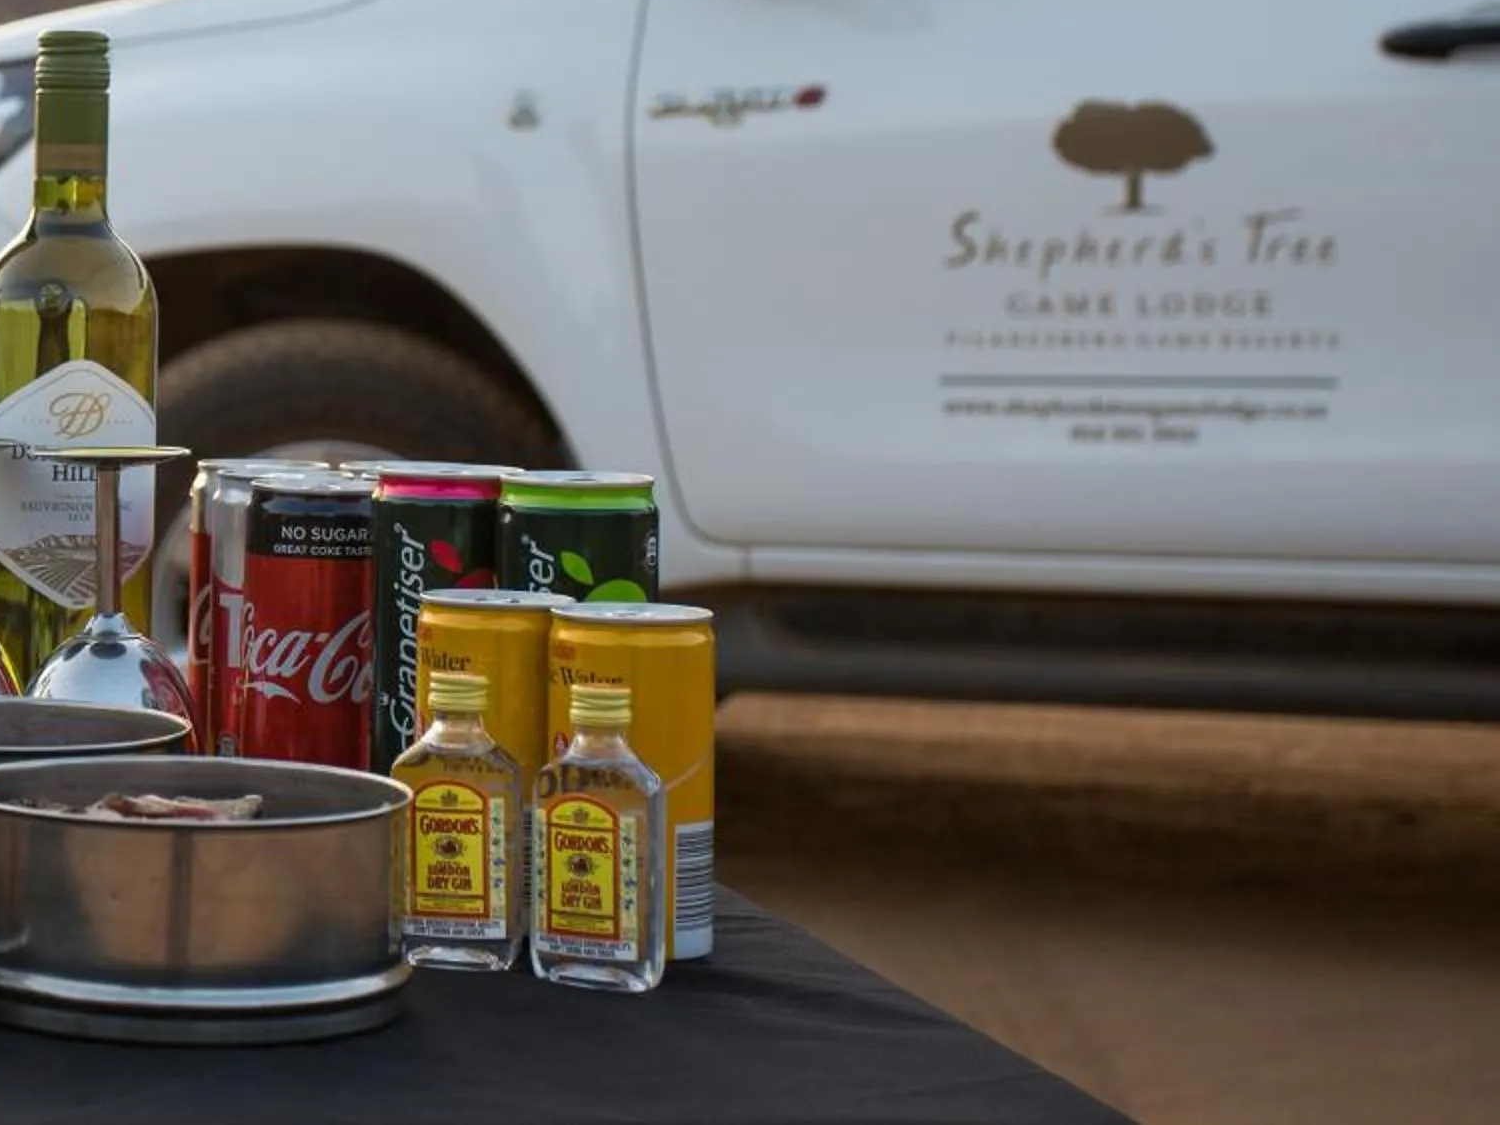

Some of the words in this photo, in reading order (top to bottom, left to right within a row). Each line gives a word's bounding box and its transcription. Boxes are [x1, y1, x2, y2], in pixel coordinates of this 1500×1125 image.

[1246, 207, 1337, 266] Tree
[51, 464, 98, 482] HILL
[281, 526, 305, 540] NO
[310, 527, 370, 541] SUGAR
[272, 543, 306, 554] GREAT
[310, 544, 342, 555] COKE
[420, 647, 471, 671] Water
[427, 877, 449, 890] DRY
[452, 878, 472, 891] GIN
